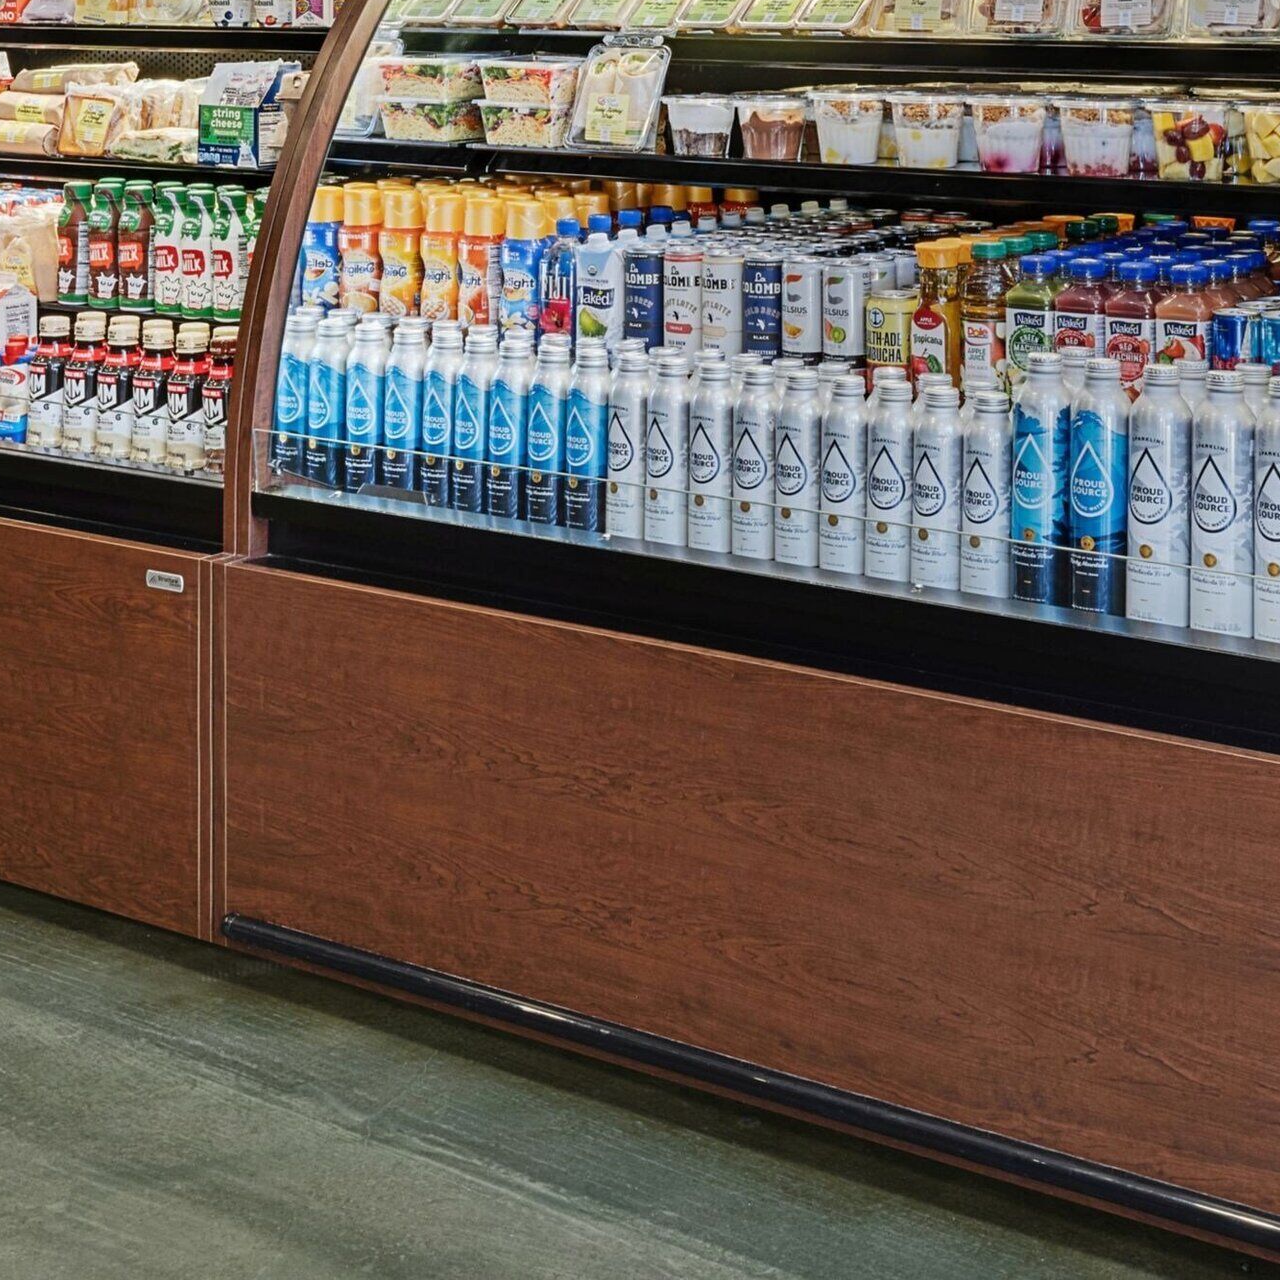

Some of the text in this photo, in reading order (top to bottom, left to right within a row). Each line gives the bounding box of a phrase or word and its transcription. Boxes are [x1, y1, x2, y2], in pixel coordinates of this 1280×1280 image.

[213, 109, 241, 119] string
[211, 119, 242, 129] cheese
[968, 327, 988, 338] Dole
[913, 333, 942, 346] Tropicana
[872, 477, 899, 485] PROUD
[1075, 478, 1105, 489] PROUD
[872, 484, 899, 492] SOURCE
[1073, 486, 1107, 497] SOURCE
[1133, 485, 1164, 495] PROUD
[1132, 493, 1165, 504] SOURCE
[1197, 493, 1228, 504] PROUD
[1195, 501, 1230, 512] SOURCE
